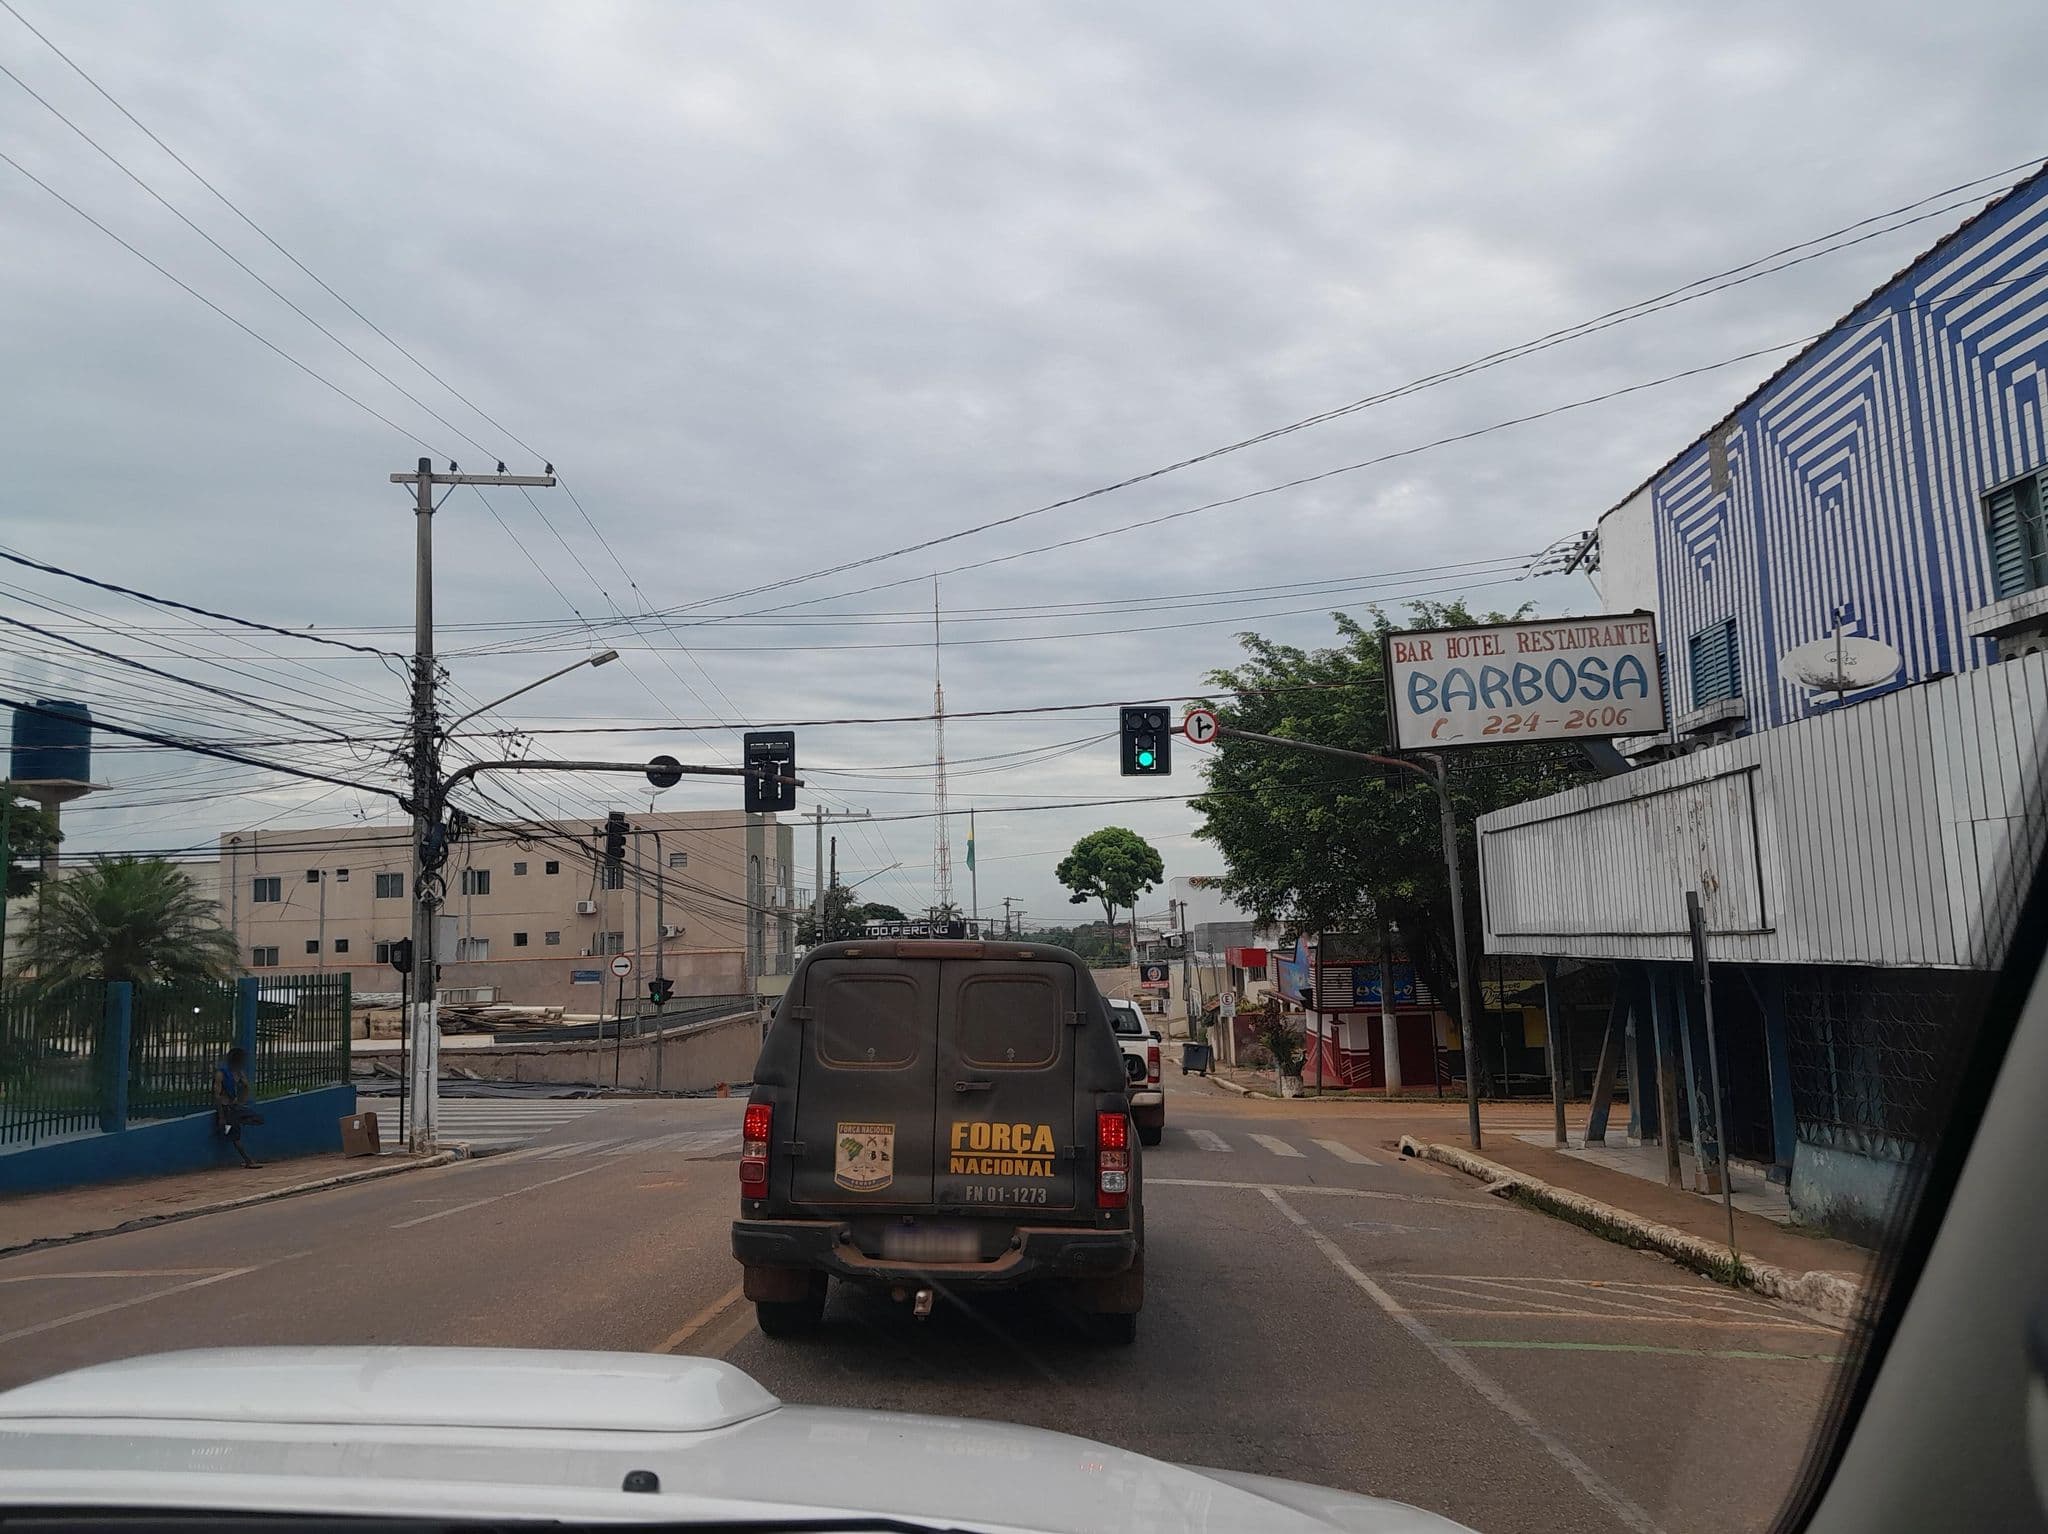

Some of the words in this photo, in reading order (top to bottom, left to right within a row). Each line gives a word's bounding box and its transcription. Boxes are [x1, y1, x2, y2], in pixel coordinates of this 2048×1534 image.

[1395, 640, 1434, 664] BAR
[1447, 634, 1506, 660] HOTEL
[1517, 622, 1651, 654] RESTAURANTE
[1407, 654, 1649, 715] BARBOSA
[951, 1122, 1056, 1157] FORÇA
[950, 1158, 1056, 1177] NACIONAL
[966, 1185, 983, 1202] FN
[987, 1186, 1047, 1204] 01-1273
